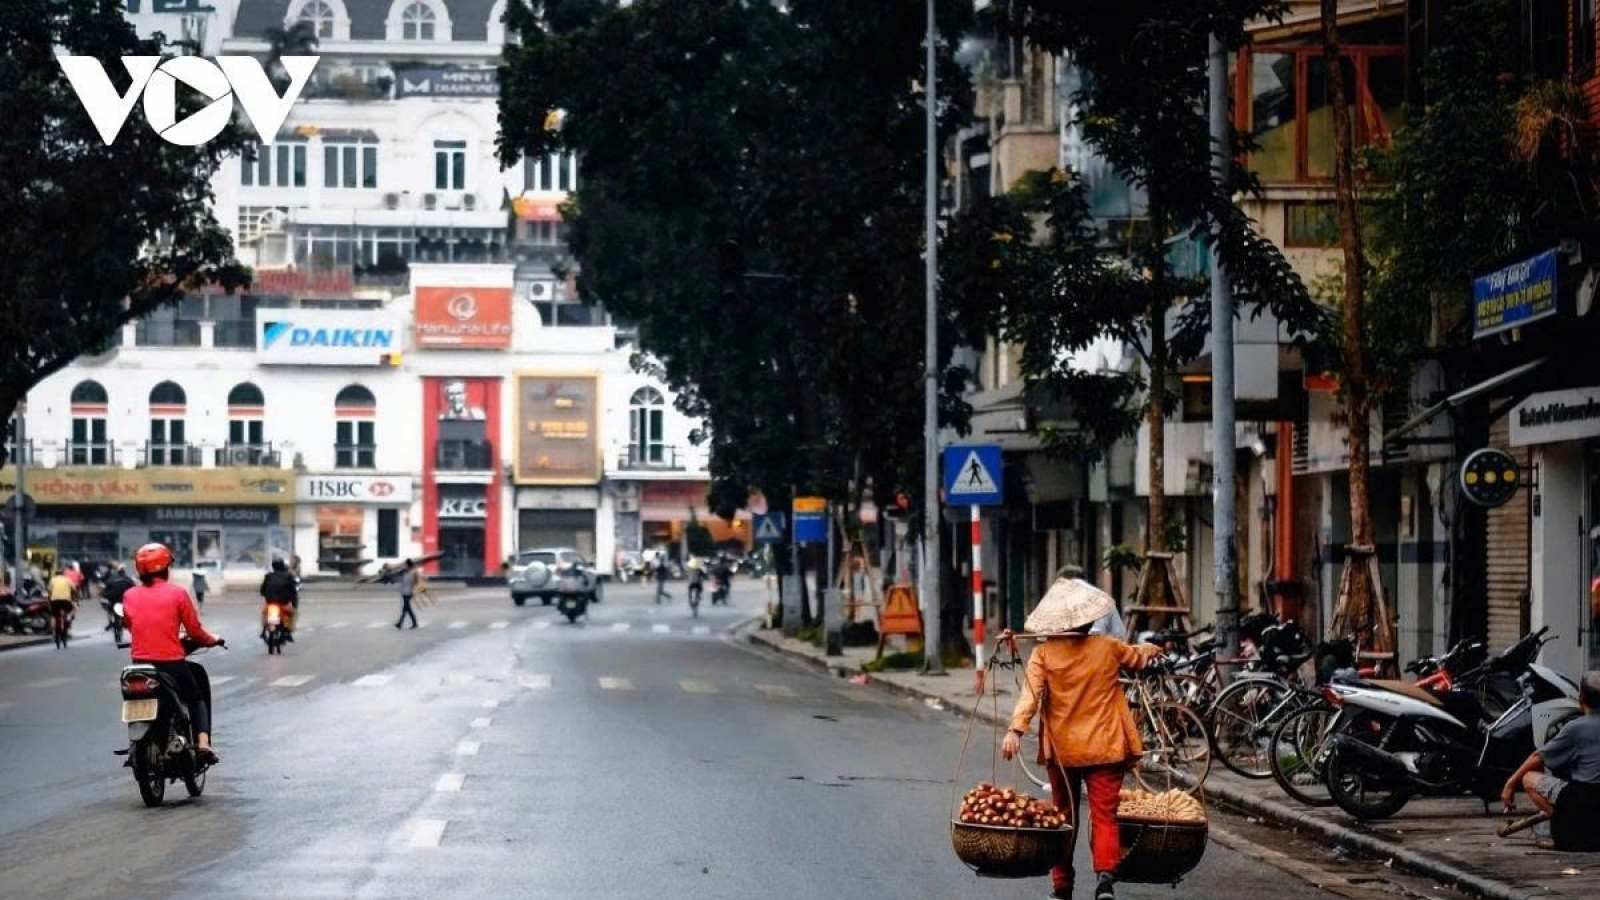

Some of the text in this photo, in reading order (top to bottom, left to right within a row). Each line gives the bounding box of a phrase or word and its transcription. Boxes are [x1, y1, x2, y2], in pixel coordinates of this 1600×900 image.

[289, 328, 394, 347] DAIKIN
[309, 480, 363, 497] HSBC
[156, 508, 221, 520] SAMSUNG
[440, 498, 487, 514] KFC
